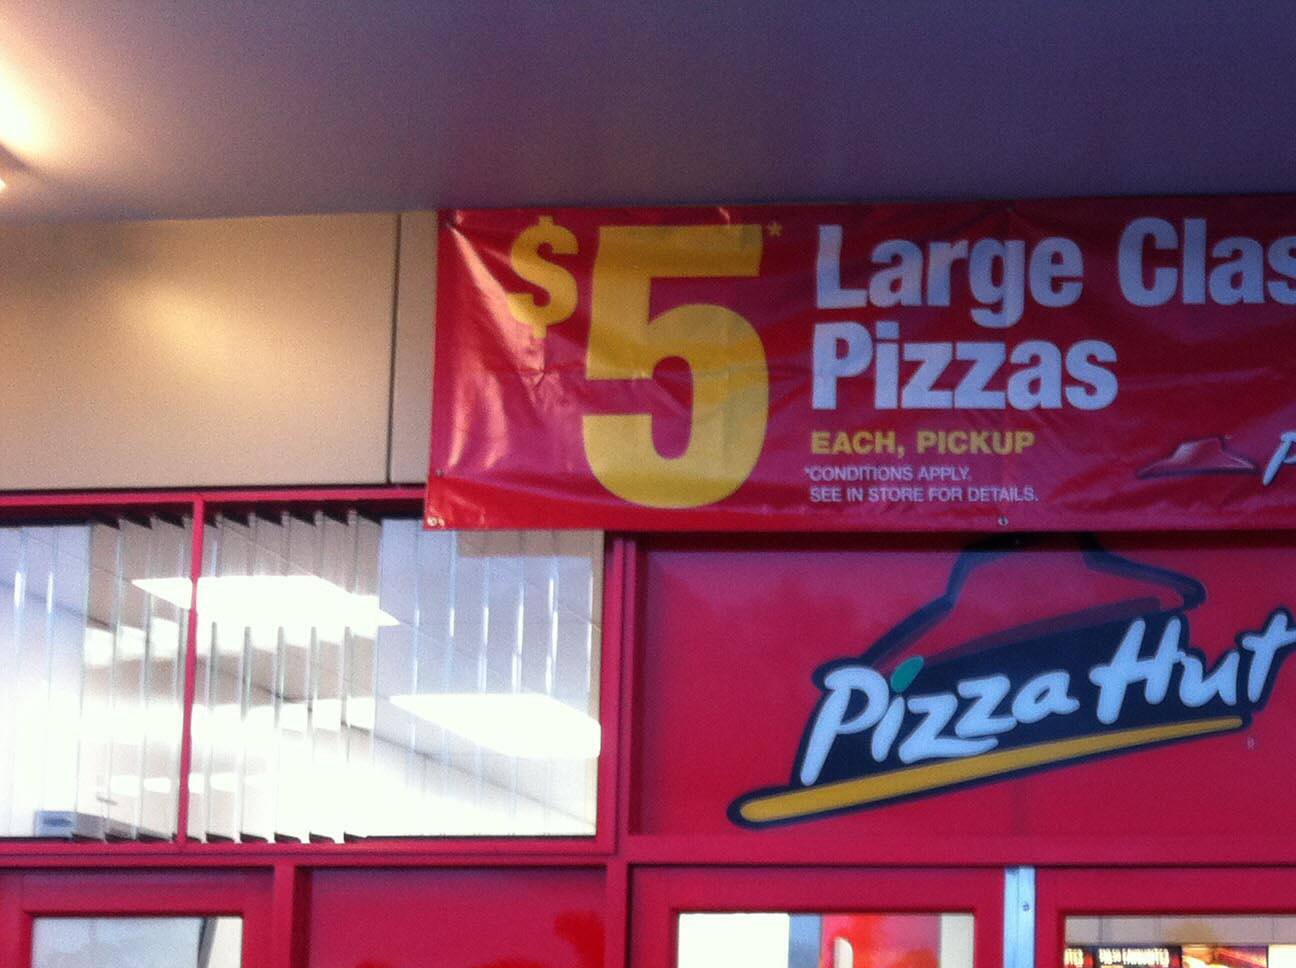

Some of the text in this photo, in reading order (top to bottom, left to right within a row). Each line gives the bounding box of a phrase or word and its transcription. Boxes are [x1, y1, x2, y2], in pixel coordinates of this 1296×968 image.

[816, 224, 1084, 328] Large
[811, 320, 1119, 410] Pizzas
[811, 431, 1035, 458] EACH, PICKUP
[810, 487, 1039, 502] SEE IN STORE FOR DETAILS.
[800, 656, 1079, 787] Pizza
